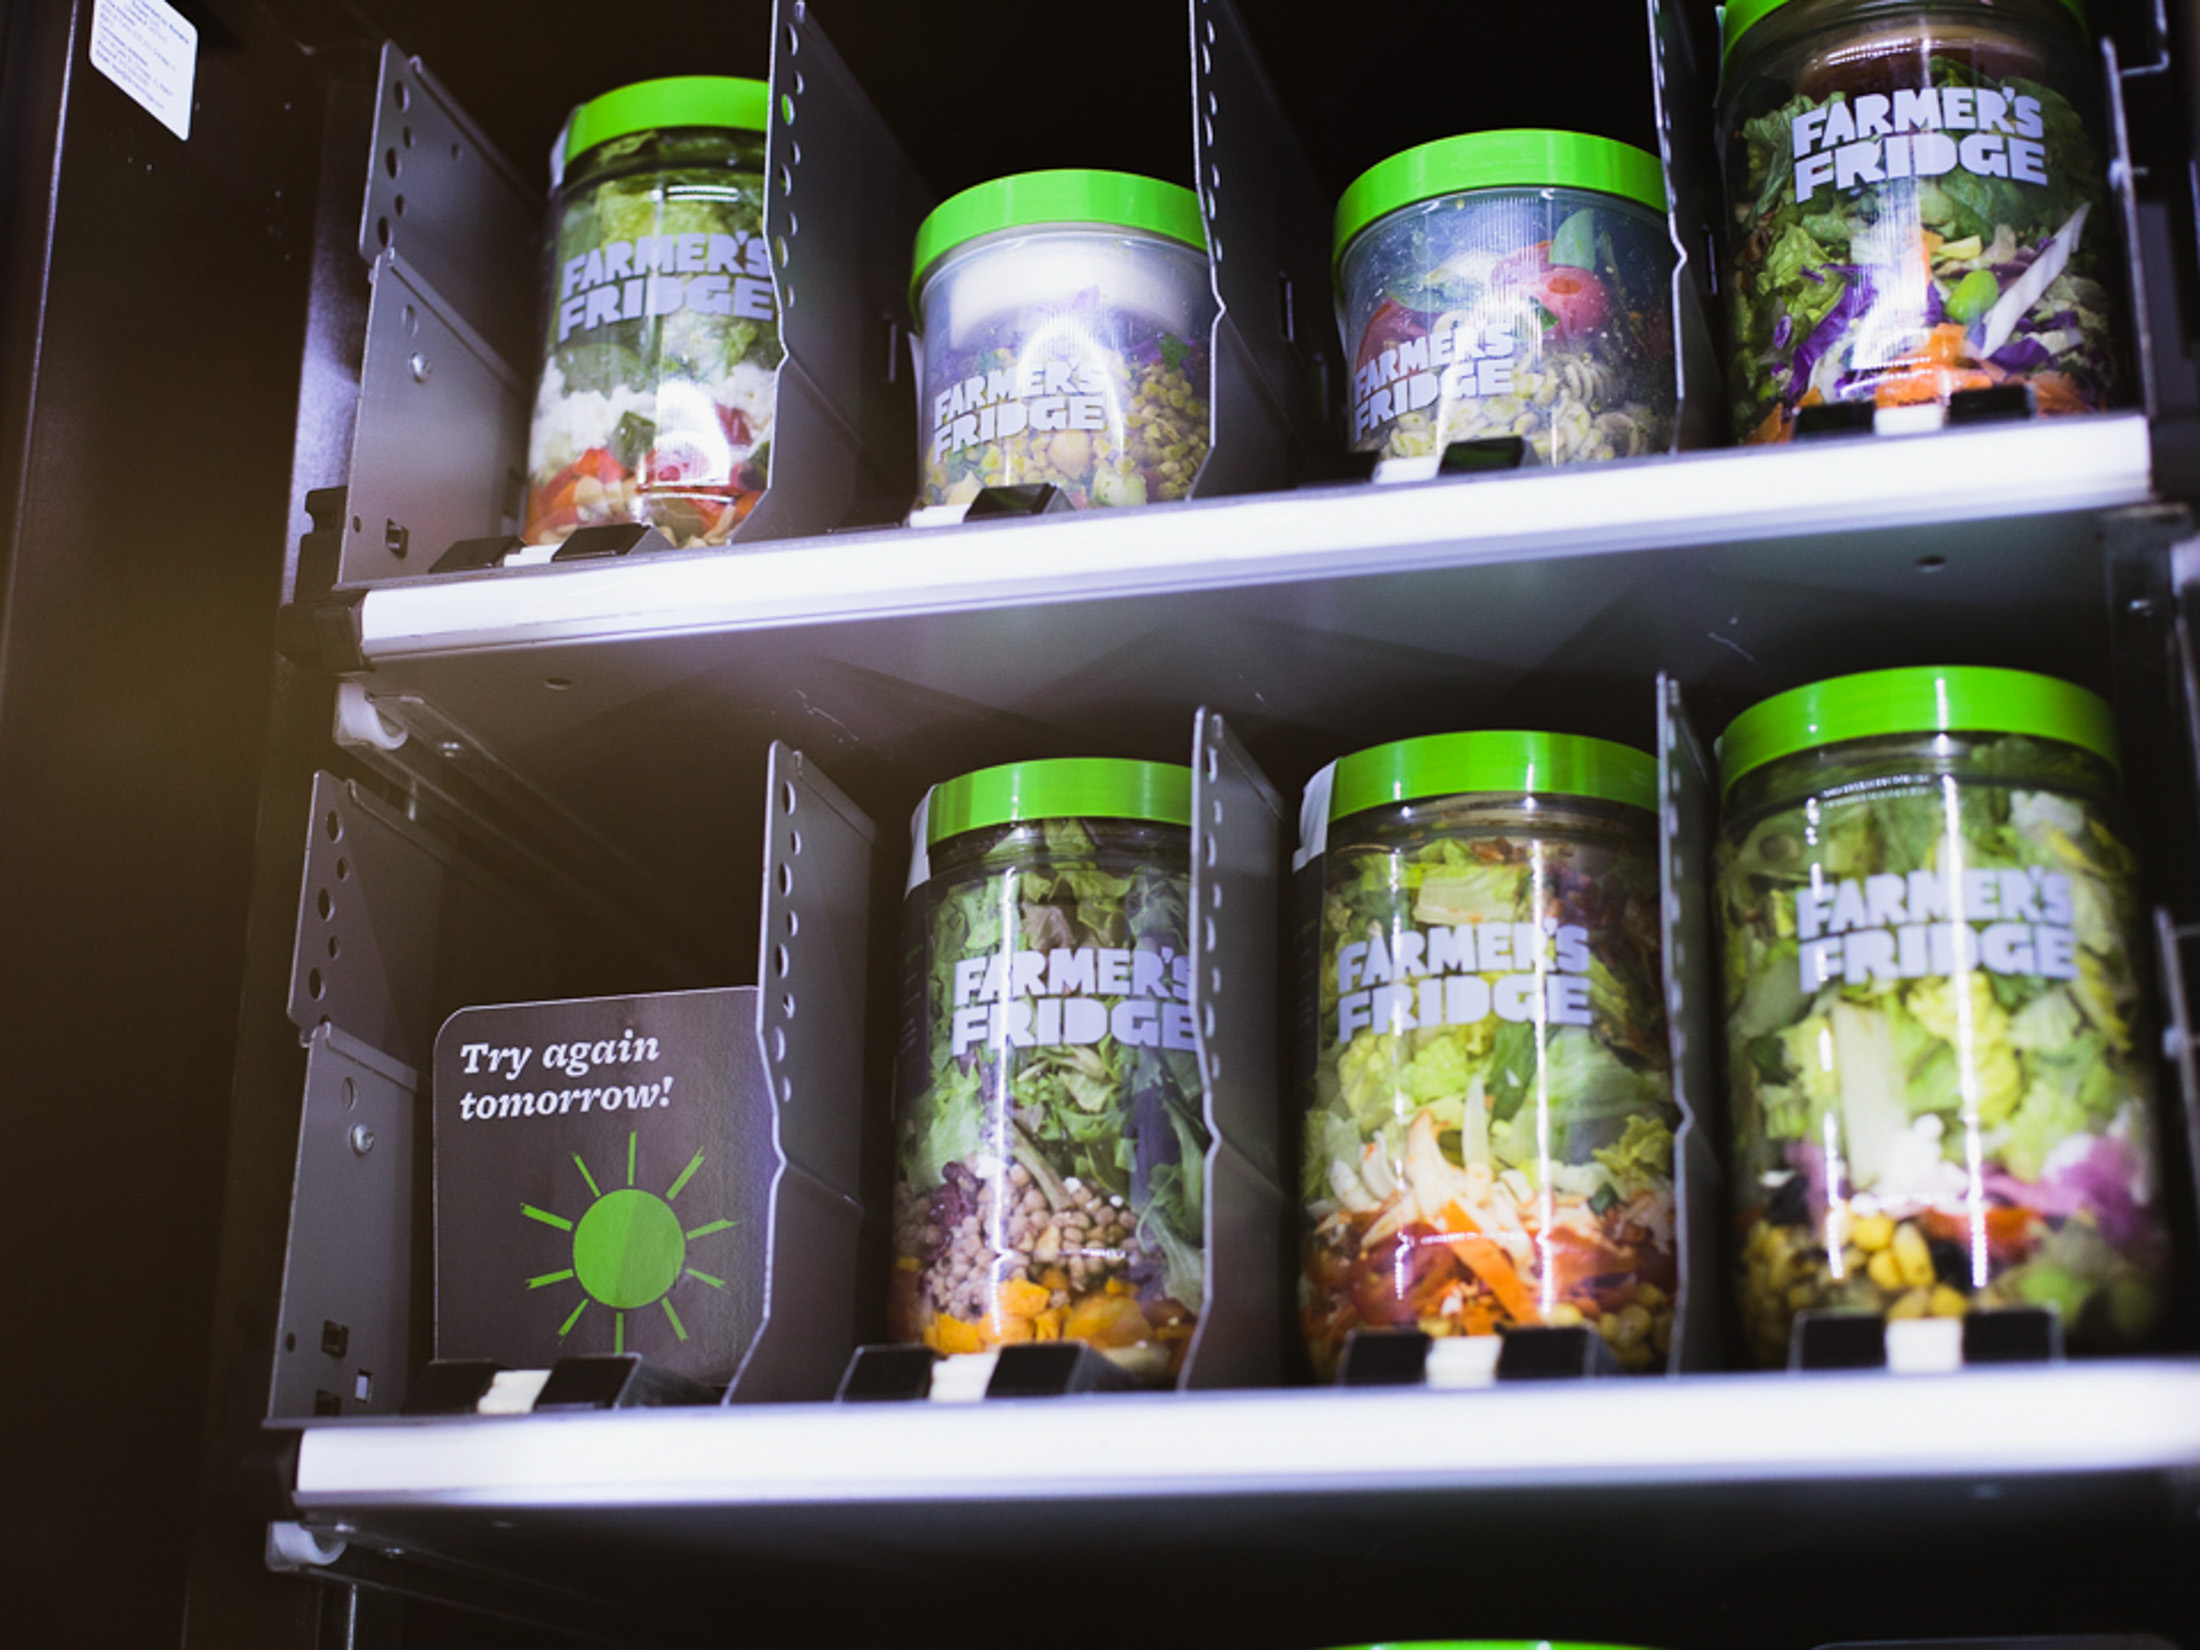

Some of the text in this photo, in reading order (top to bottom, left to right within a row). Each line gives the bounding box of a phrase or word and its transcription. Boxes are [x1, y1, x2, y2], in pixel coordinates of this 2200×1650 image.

[1792, 86, 2044, 159] FARMER'S
[1794, 132, 2048, 203] FRIDGE
[561, 230, 770, 299] FARMER'S
[558, 274, 774, 343] FRIDGE
[1354, 322, 1514, 408] FARMERS
[1355, 357, 1514, 442] FRIDGE
[934, 395, 1105, 464] FRIDGE
[1797, 865, 2074, 940] FARMER'S
[953, 946, 1191, 1006] FARMER'S
[1337, 916, 1591, 993] FARMER'S
[1800, 922, 2079, 994] FRIDGE
[952, 997, 1197, 1056] FRIDGE
[1338, 973, 1594, 1044] FRIDGE
[459, 1028, 661, 1081] Try again
[459, 1075, 675, 1121] tomorrow!
